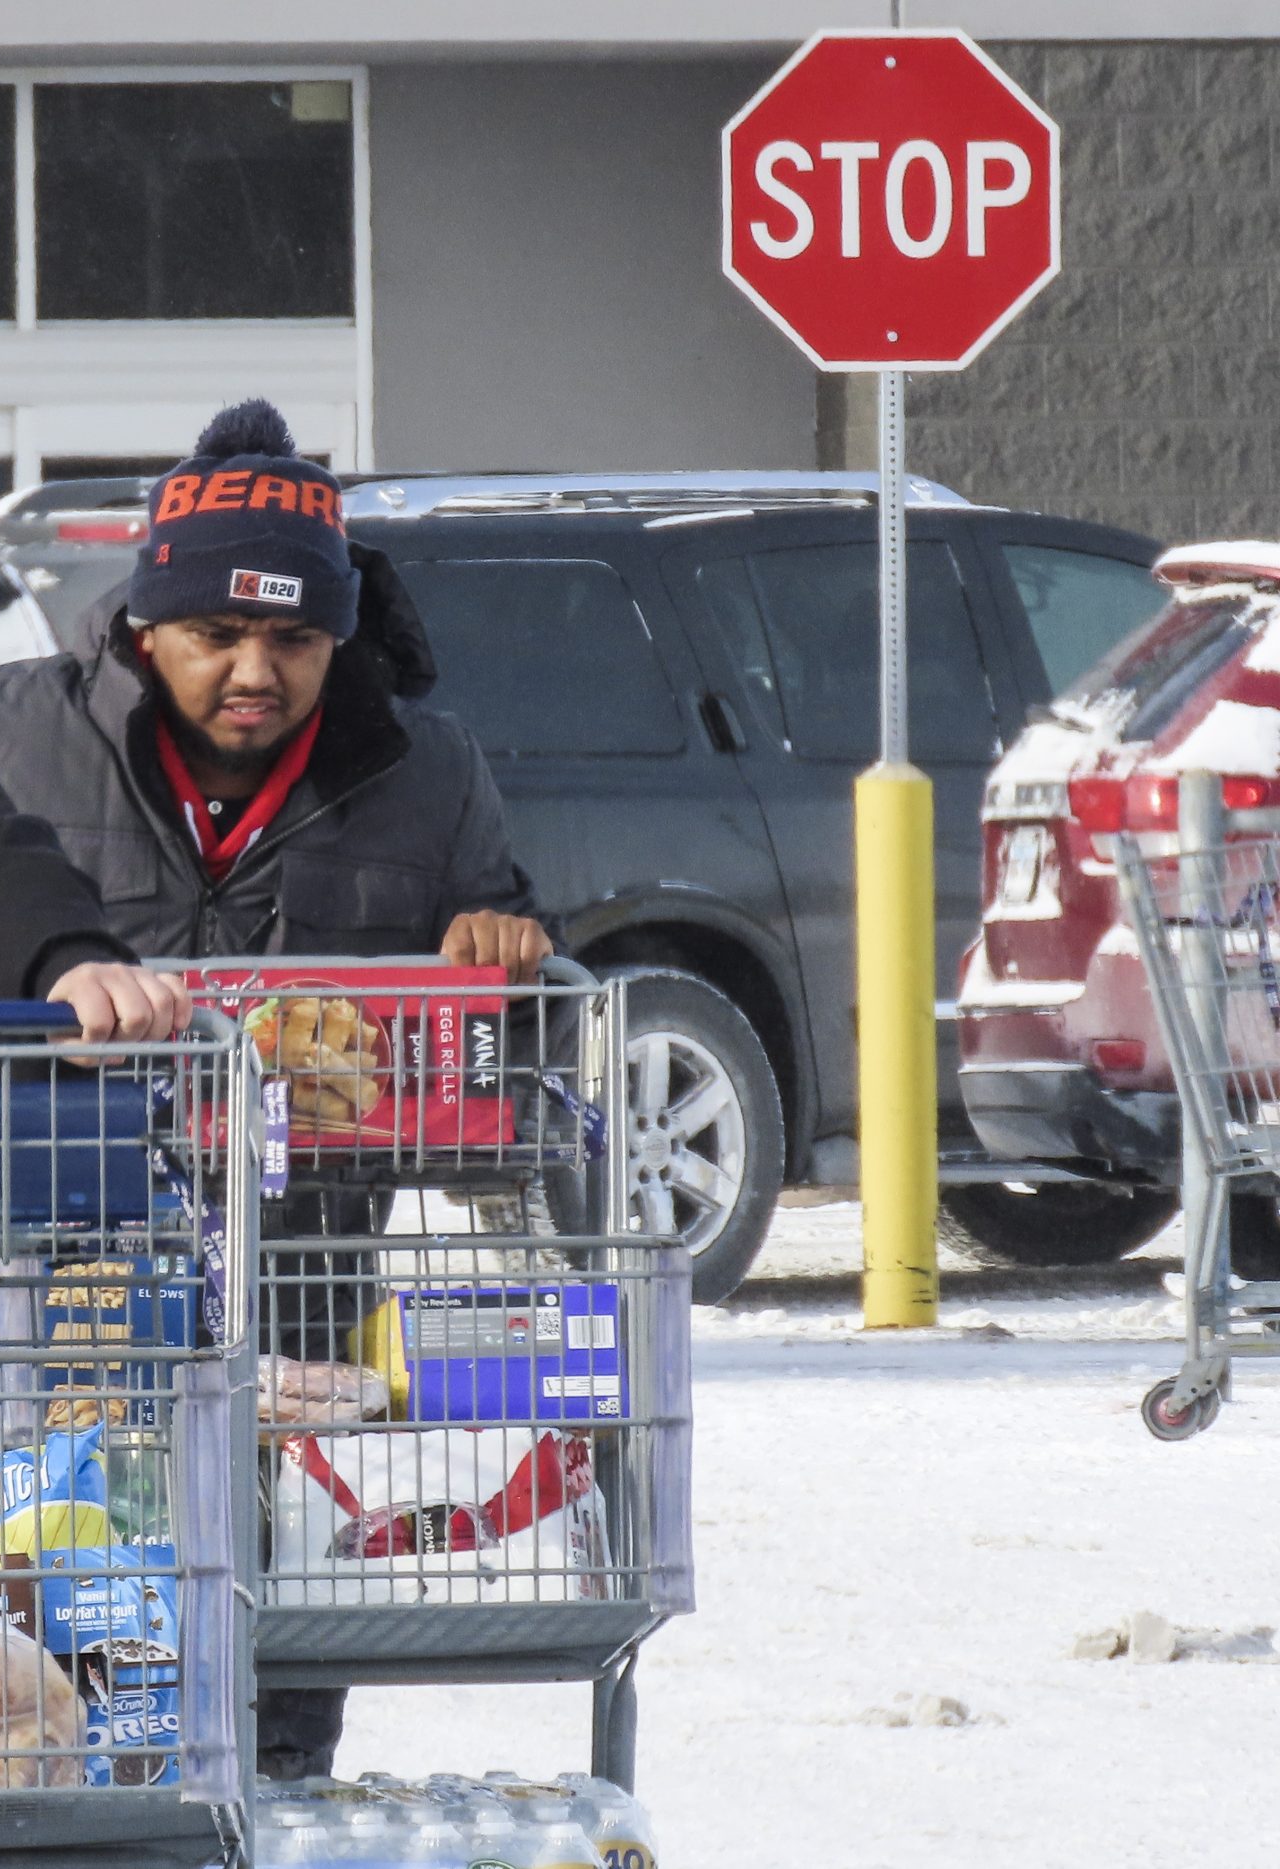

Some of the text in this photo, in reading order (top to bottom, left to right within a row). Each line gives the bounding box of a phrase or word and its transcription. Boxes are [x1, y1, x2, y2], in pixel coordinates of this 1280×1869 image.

[750, 139, 1032, 260] STOP
[262, 580, 296, 598] 1920
[439, 1007, 453, 1043] EGG
[138, 1288, 185, 1299] ELOWS
[86, 1713, 179, 1749] OREO
